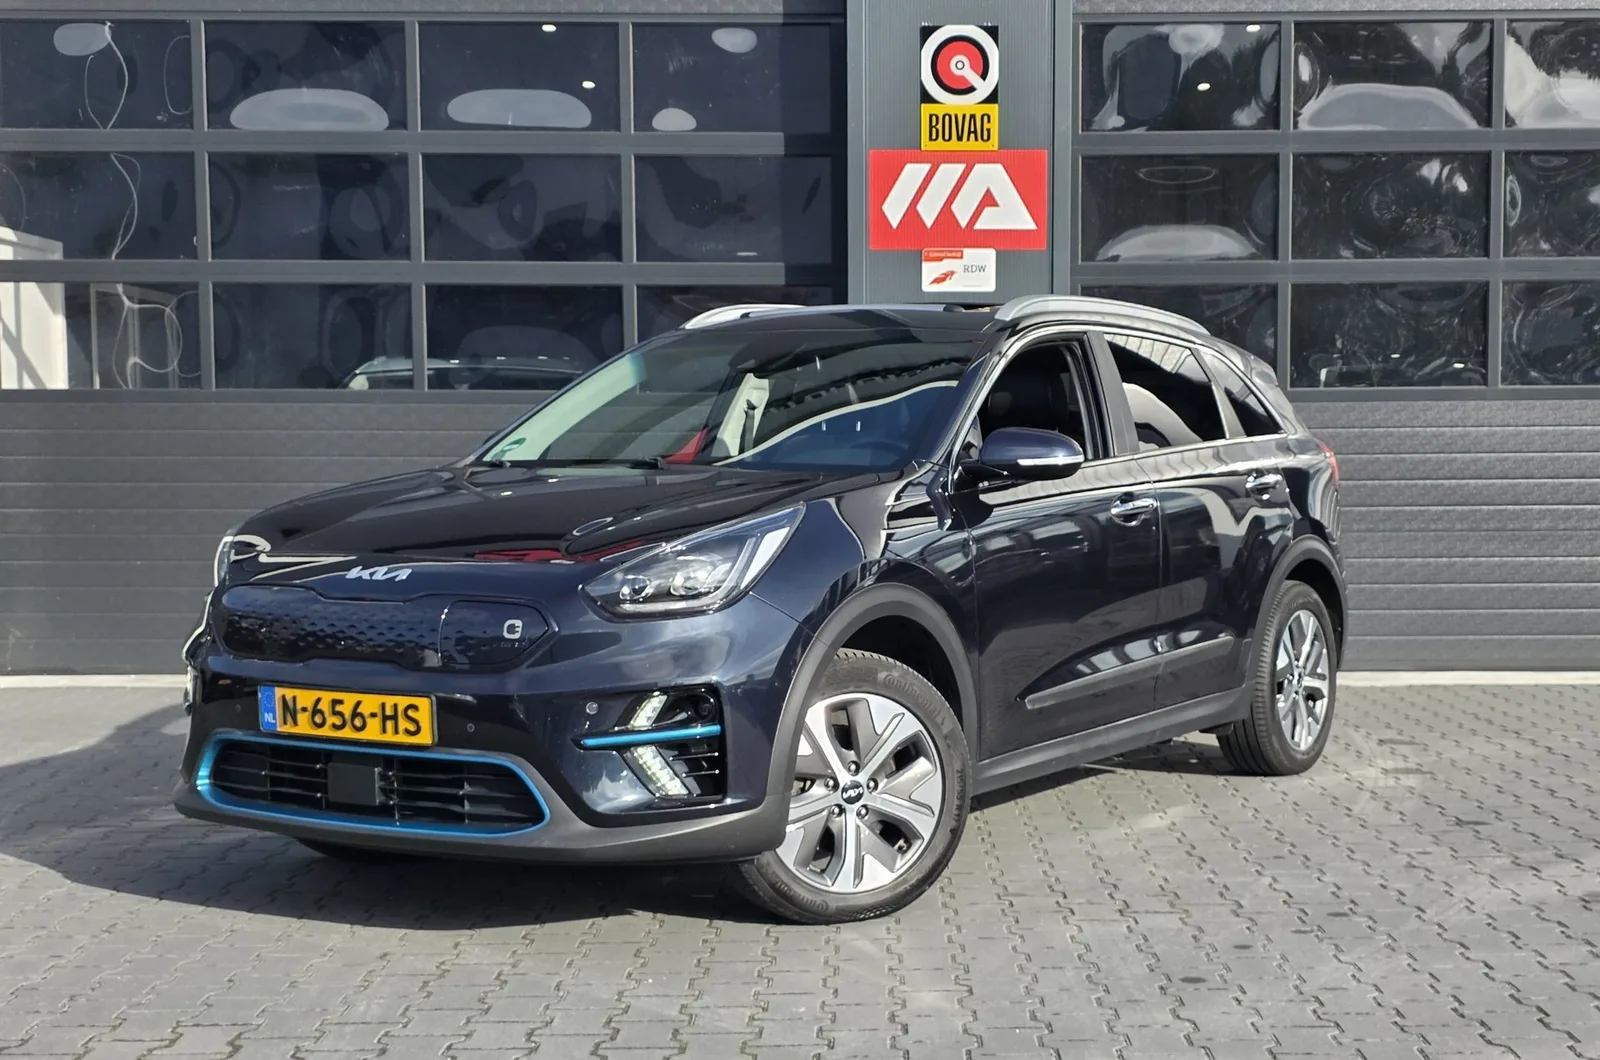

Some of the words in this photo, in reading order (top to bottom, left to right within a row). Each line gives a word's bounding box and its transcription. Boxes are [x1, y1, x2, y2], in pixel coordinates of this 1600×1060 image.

[928, 113, 991, 142] BOVAG
[963, 264, 987, 273] RDW
[345, 566, 412, 581] KIA
[264, 713, 276, 724] NL
[282, 694, 422, 736] N-656-HS
